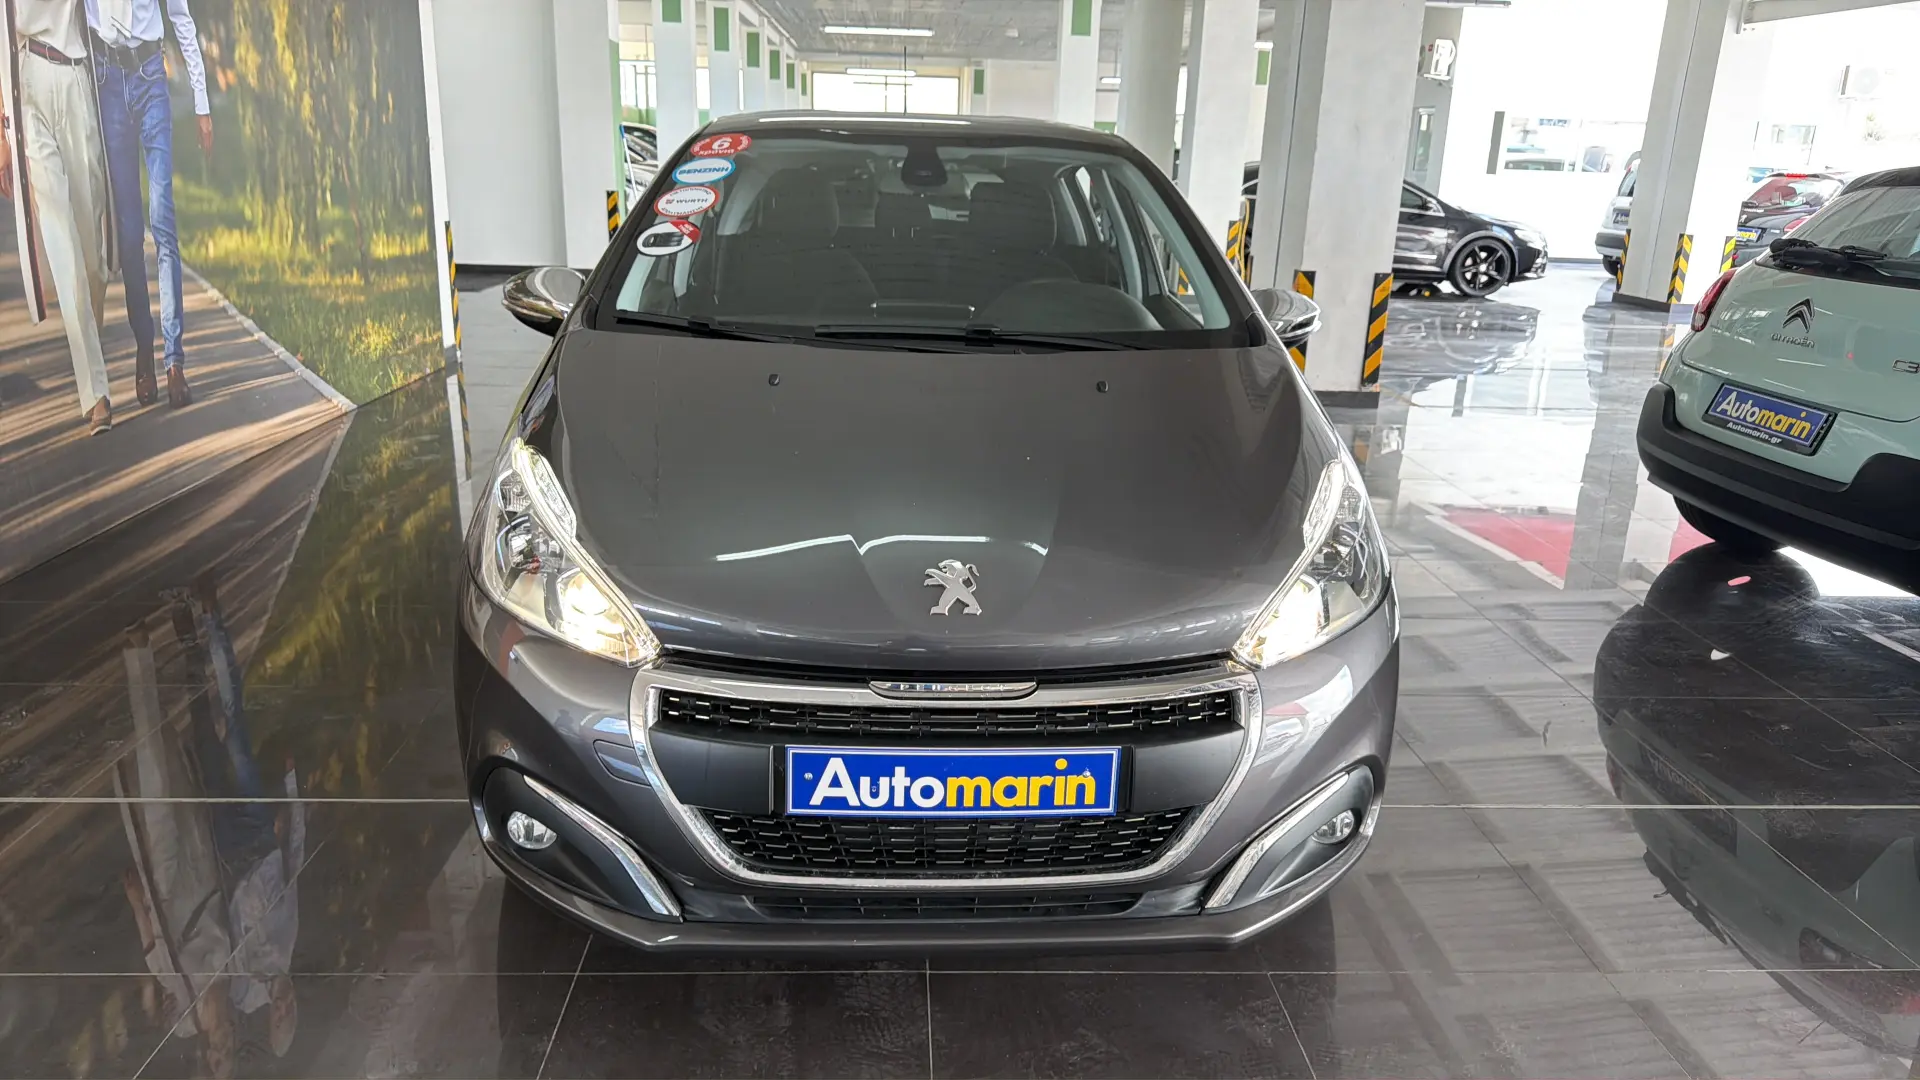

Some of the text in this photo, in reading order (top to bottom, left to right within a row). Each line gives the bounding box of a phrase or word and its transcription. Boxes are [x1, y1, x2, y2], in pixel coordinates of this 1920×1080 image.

[711, 136, 732, 150] 6
[1771, 332, 1815, 348] CITROËN
[1892, 359, 1920, 374] C3
[1716, 391, 1811, 439] Automarin
[1726, 422, 1782, 444] Automarin.gr
[809, 757, 1097, 808] Automarin
